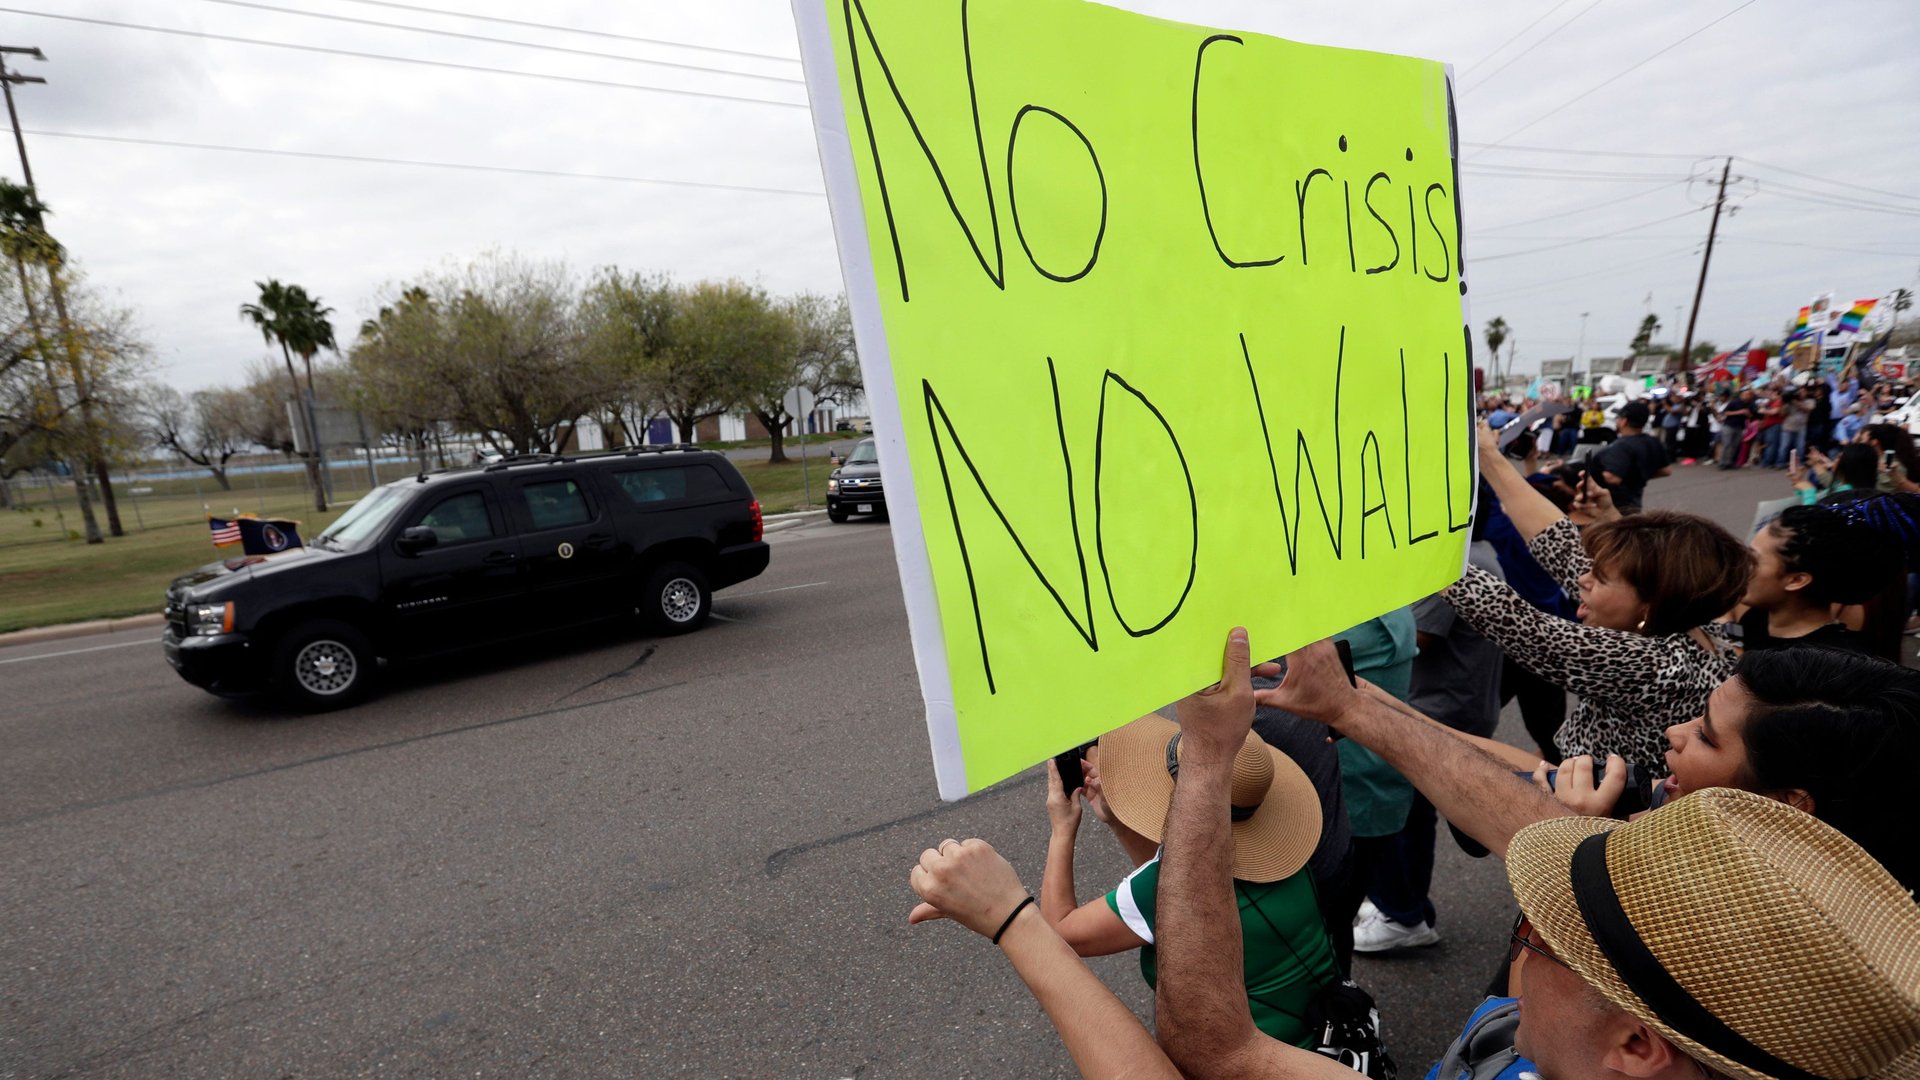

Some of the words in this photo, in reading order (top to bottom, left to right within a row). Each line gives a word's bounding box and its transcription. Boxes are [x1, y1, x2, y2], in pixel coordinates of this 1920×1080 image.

[843, 0, 1107, 303] No
[1191, 34, 1468, 297] Crisis!
[921, 355, 1198, 695] NO
[1239, 324, 1477, 577] WALL!
